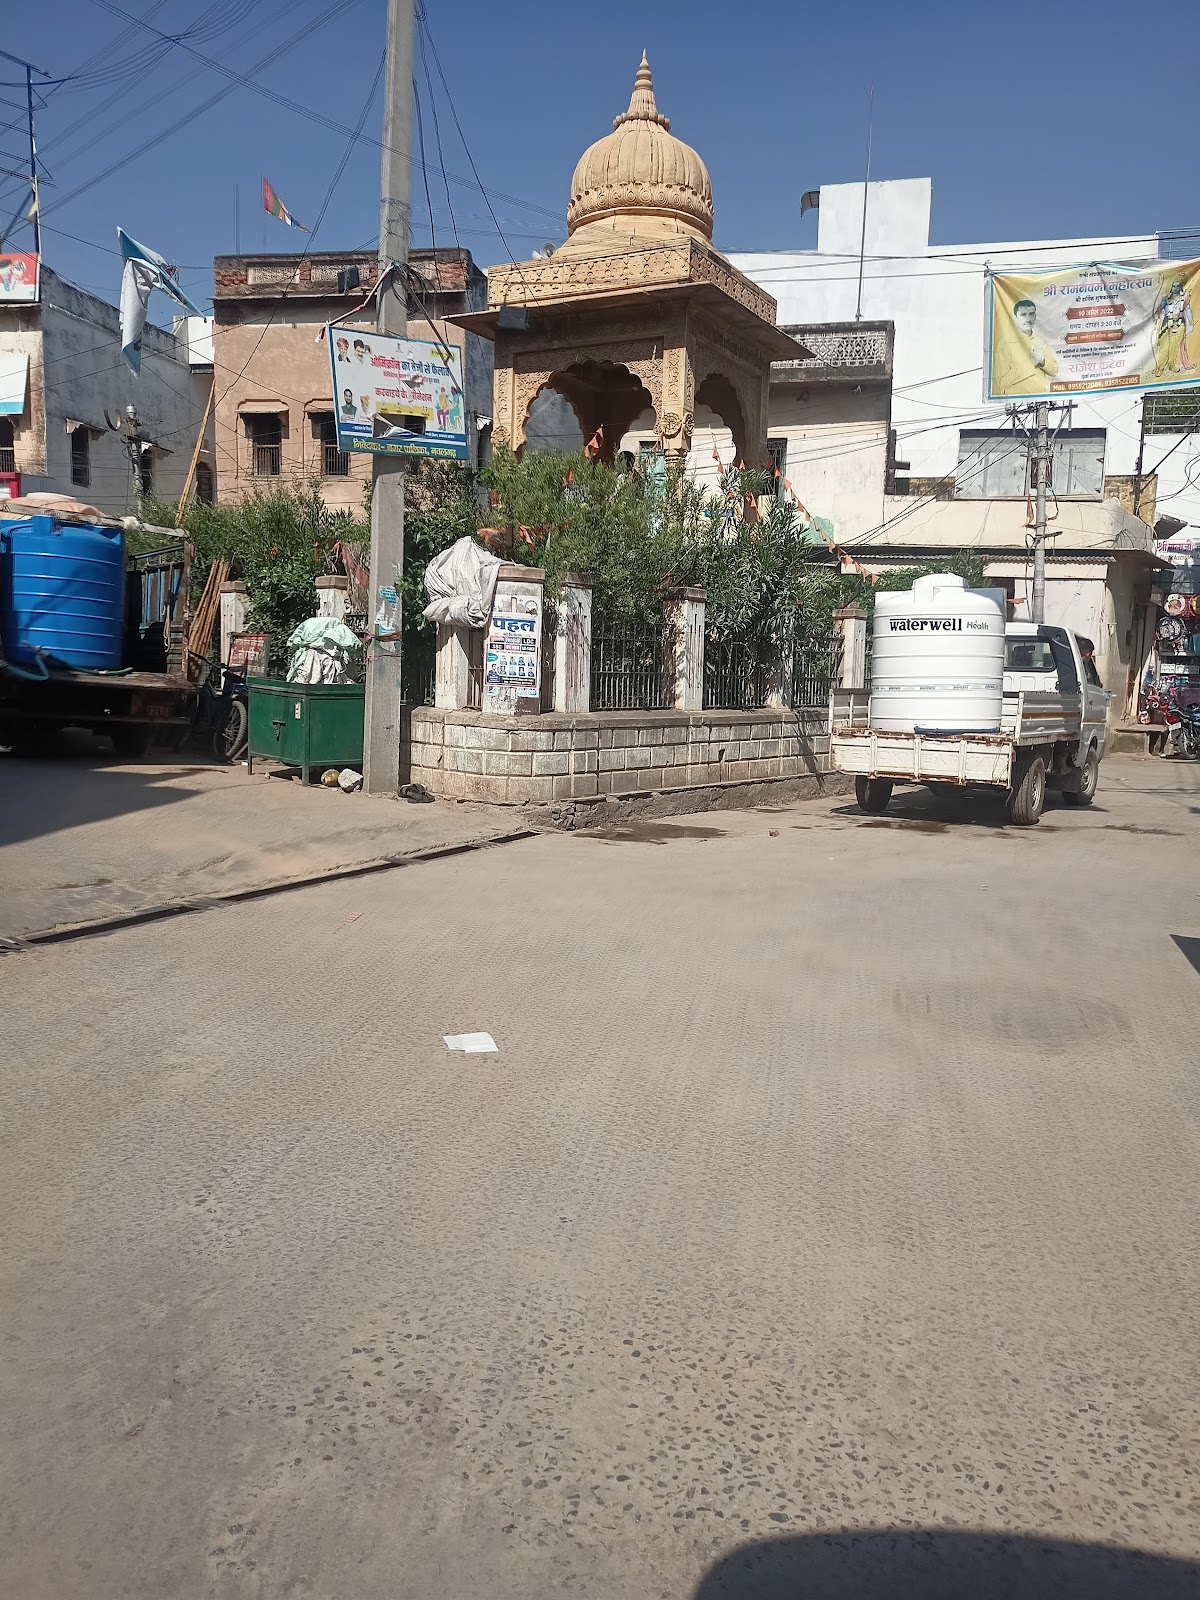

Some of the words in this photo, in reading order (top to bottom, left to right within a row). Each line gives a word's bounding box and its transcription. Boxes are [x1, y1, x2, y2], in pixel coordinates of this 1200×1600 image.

[1044, 283, 1057, 297] श्री
[1060, 279, 1106, 295] रामनवमी
[1109, 276, 1153, 291] महोत्सव
[1099, 307, 1114, 315] 2022
[370, 354, 400, 370] ओमिक्रॉन
[401, 361, 411, 371] का
[411, 359, 424, 374] तेजी
[424, 361, 431, 374] से
[1069, 361, 1097, 373] राजेश
[386, 443, 403, 454] नगर
[1158, 541, 1167, 551] श्री
[492, 617, 536, 632] पहल
[889, 618, 963, 631] waterwell
